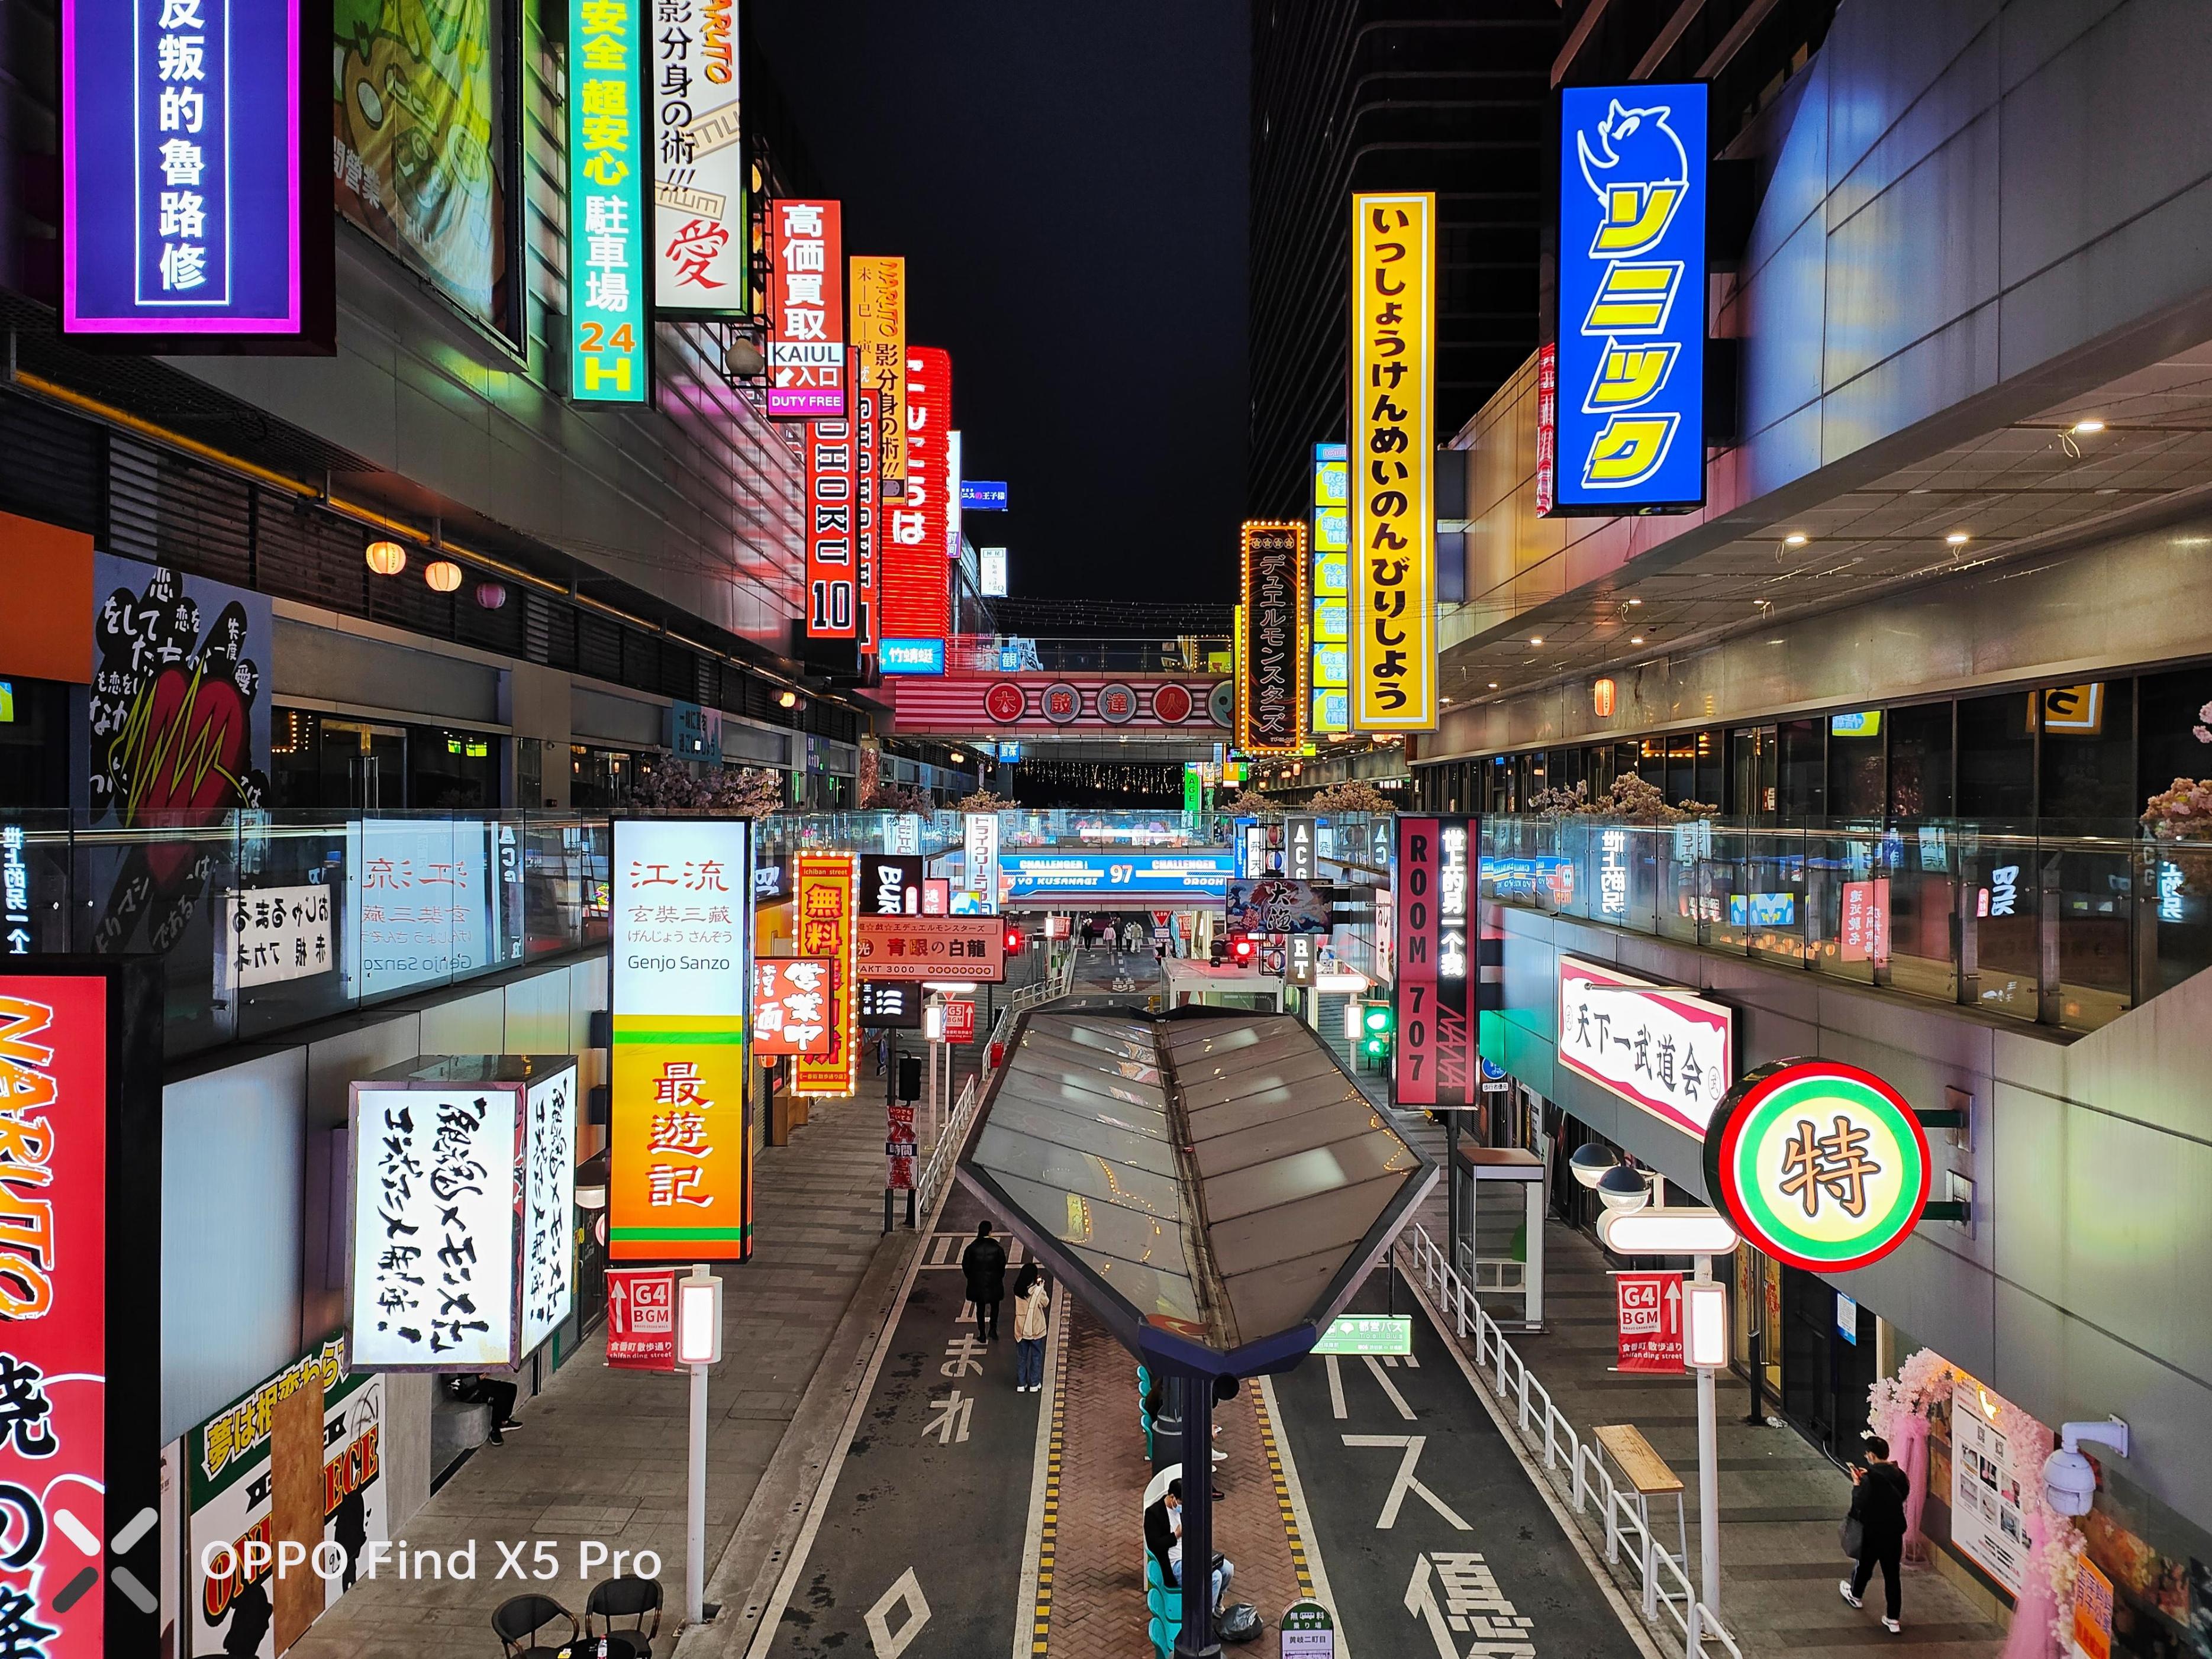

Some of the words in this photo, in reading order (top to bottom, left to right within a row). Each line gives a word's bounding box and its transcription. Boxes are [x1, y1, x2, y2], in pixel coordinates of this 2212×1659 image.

[581, 78, 630, 187] 超安心
[585, 195, 628, 312] 駐車場
[665, 220, 729, 290] 愛
[782, 204, 826, 341] 高価買取
[579, 323, 635, 351] 24
[773, 345, 840, 363] KAIUL
[585, 359, 631, 391] H
[795, 366, 838, 387] 入口
[772, 396, 805, 406] DUTY
[810, 396, 841, 406] FREE
[1370, 208, 1410, 711] いっしょうけんめいのんびりしよう
[812, 580, 852, 631] 10
[1259, 555, 1285, 732] デュエルモンスターズ
[889, 645, 934, 664] 竹蜻蜓
[1002, 653, 1017, 667] 観
[631, 860, 729, 892] 江流
[1110, 864, 1133, 884] 97
[1409, 835, 1427, 964] ROOM
[1442, 829, 1465, 976] 世上的另一个我
[627, 929, 685, 943] げんじょう
[688, 930, 733, 943] さんぞう
[888, 939, 986, 957] 青眼の白龍
[628, 956, 676, 971] Genjo
[681, 956, 730, 969] Sanzo
[782, 963, 826, 1051] 営業中
[1409, 987, 1427, 1082] 707
[1576, 1003, 1703, 1102] 天下一武道会
[646, 1061, 712, 1208] 最遊記
[889, 1122, 915, 1142] 24
[890, 1145, 912, 1155] 時間
[1780, 1116, 1880, 1217] 特
[636, 1284, 666, 1304] G4
[1624, 1287, 1655, 1306] G4
[634, 1310, 668, 1322] BGM
[1623, 1311, 1657, 1324] BGM
[1359, 1322, 1402, 1332] 都営バス
[637, 1342, 672, 1352] 散歩通り
[1648, 1342, 1682, 1351] 散歩通り
